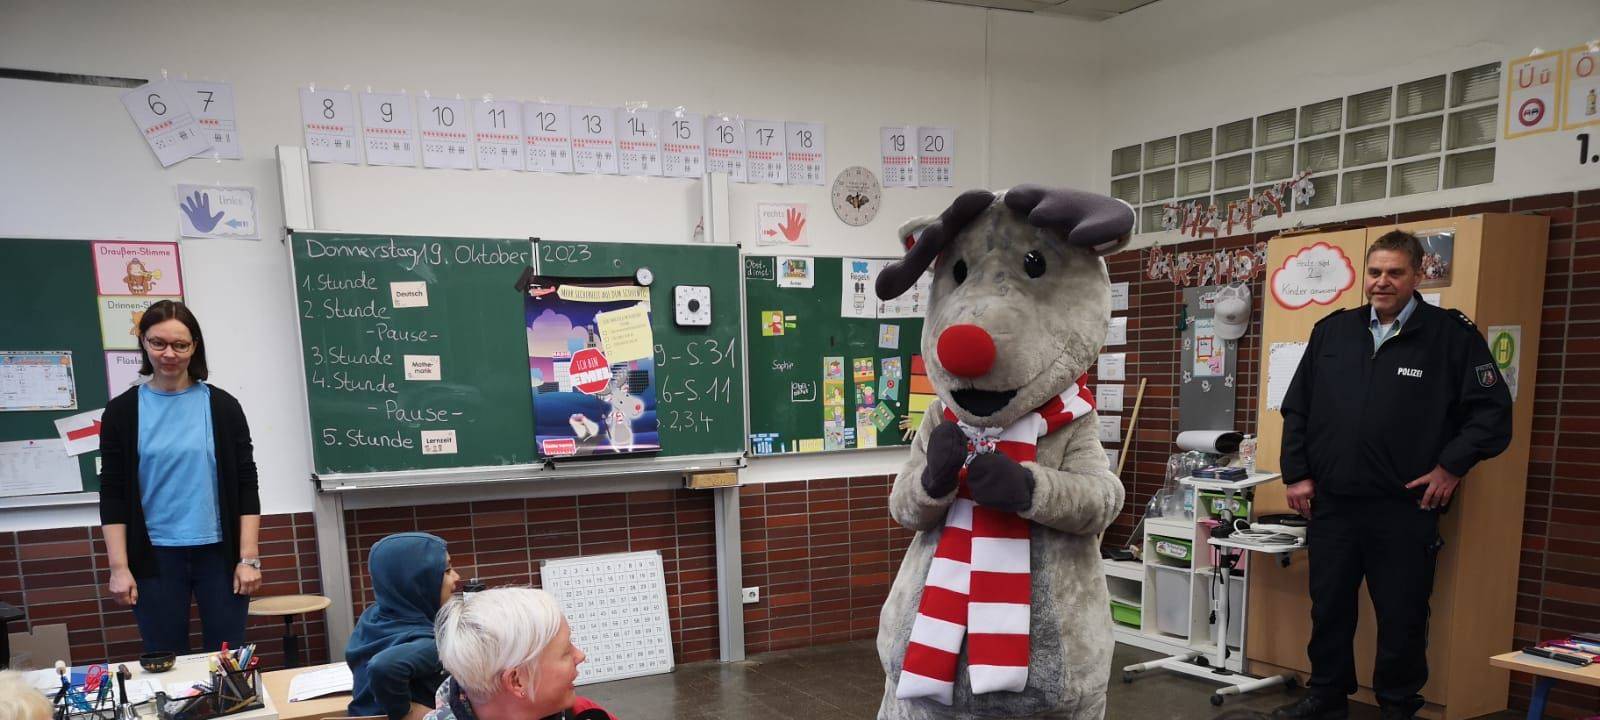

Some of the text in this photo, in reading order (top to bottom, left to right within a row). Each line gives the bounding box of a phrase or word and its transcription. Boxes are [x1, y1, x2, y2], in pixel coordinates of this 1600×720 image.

[148, 93, 167, 116] 6
[197, 90, 215, 112] 7
[323, 98, 335, 119] 8
[380, 102, 393, 123] 9
[432, 106, 455, 127] 10
[488, 108, 506, 129] 11
[536, 111, 557, 132] 12
[582, 114, 602, 134] 13
[627, 117, 647, 137] 14
[672, 120, 691, 139] 15
[716, 125, 735, 144] 16
[755, 128, 775, 146] 17
[796, 130, 813, 148] 18
[890, 134, 905, 152] 19
[925, 135, 944, 152] 20
[1576, 133, 1599, 165] 1.
[763, 209, 785, 218] rechts
[100, 246, 170, 258] Draußen-Stimme
[306, 238, 420, 271] Donnerstag
[455, 243, 529, 265] Oktober
[543, 244, 592, 263] 2023
[317, 270, 378, 290] Stunde
[1281, 282, 1307, 296] Kinder
[396, 290, 423, 298] Deutsch
[323, 300, 391, 320] Stunde
[329, 346, 393, 365] Stunde
[1397, 367, 1423, 378] POLIZEI
[332, 372, 399, 394] Stunde
[346, 429, 415, 449] Stunde
[426, 436, 452, 444] Lernzeit
